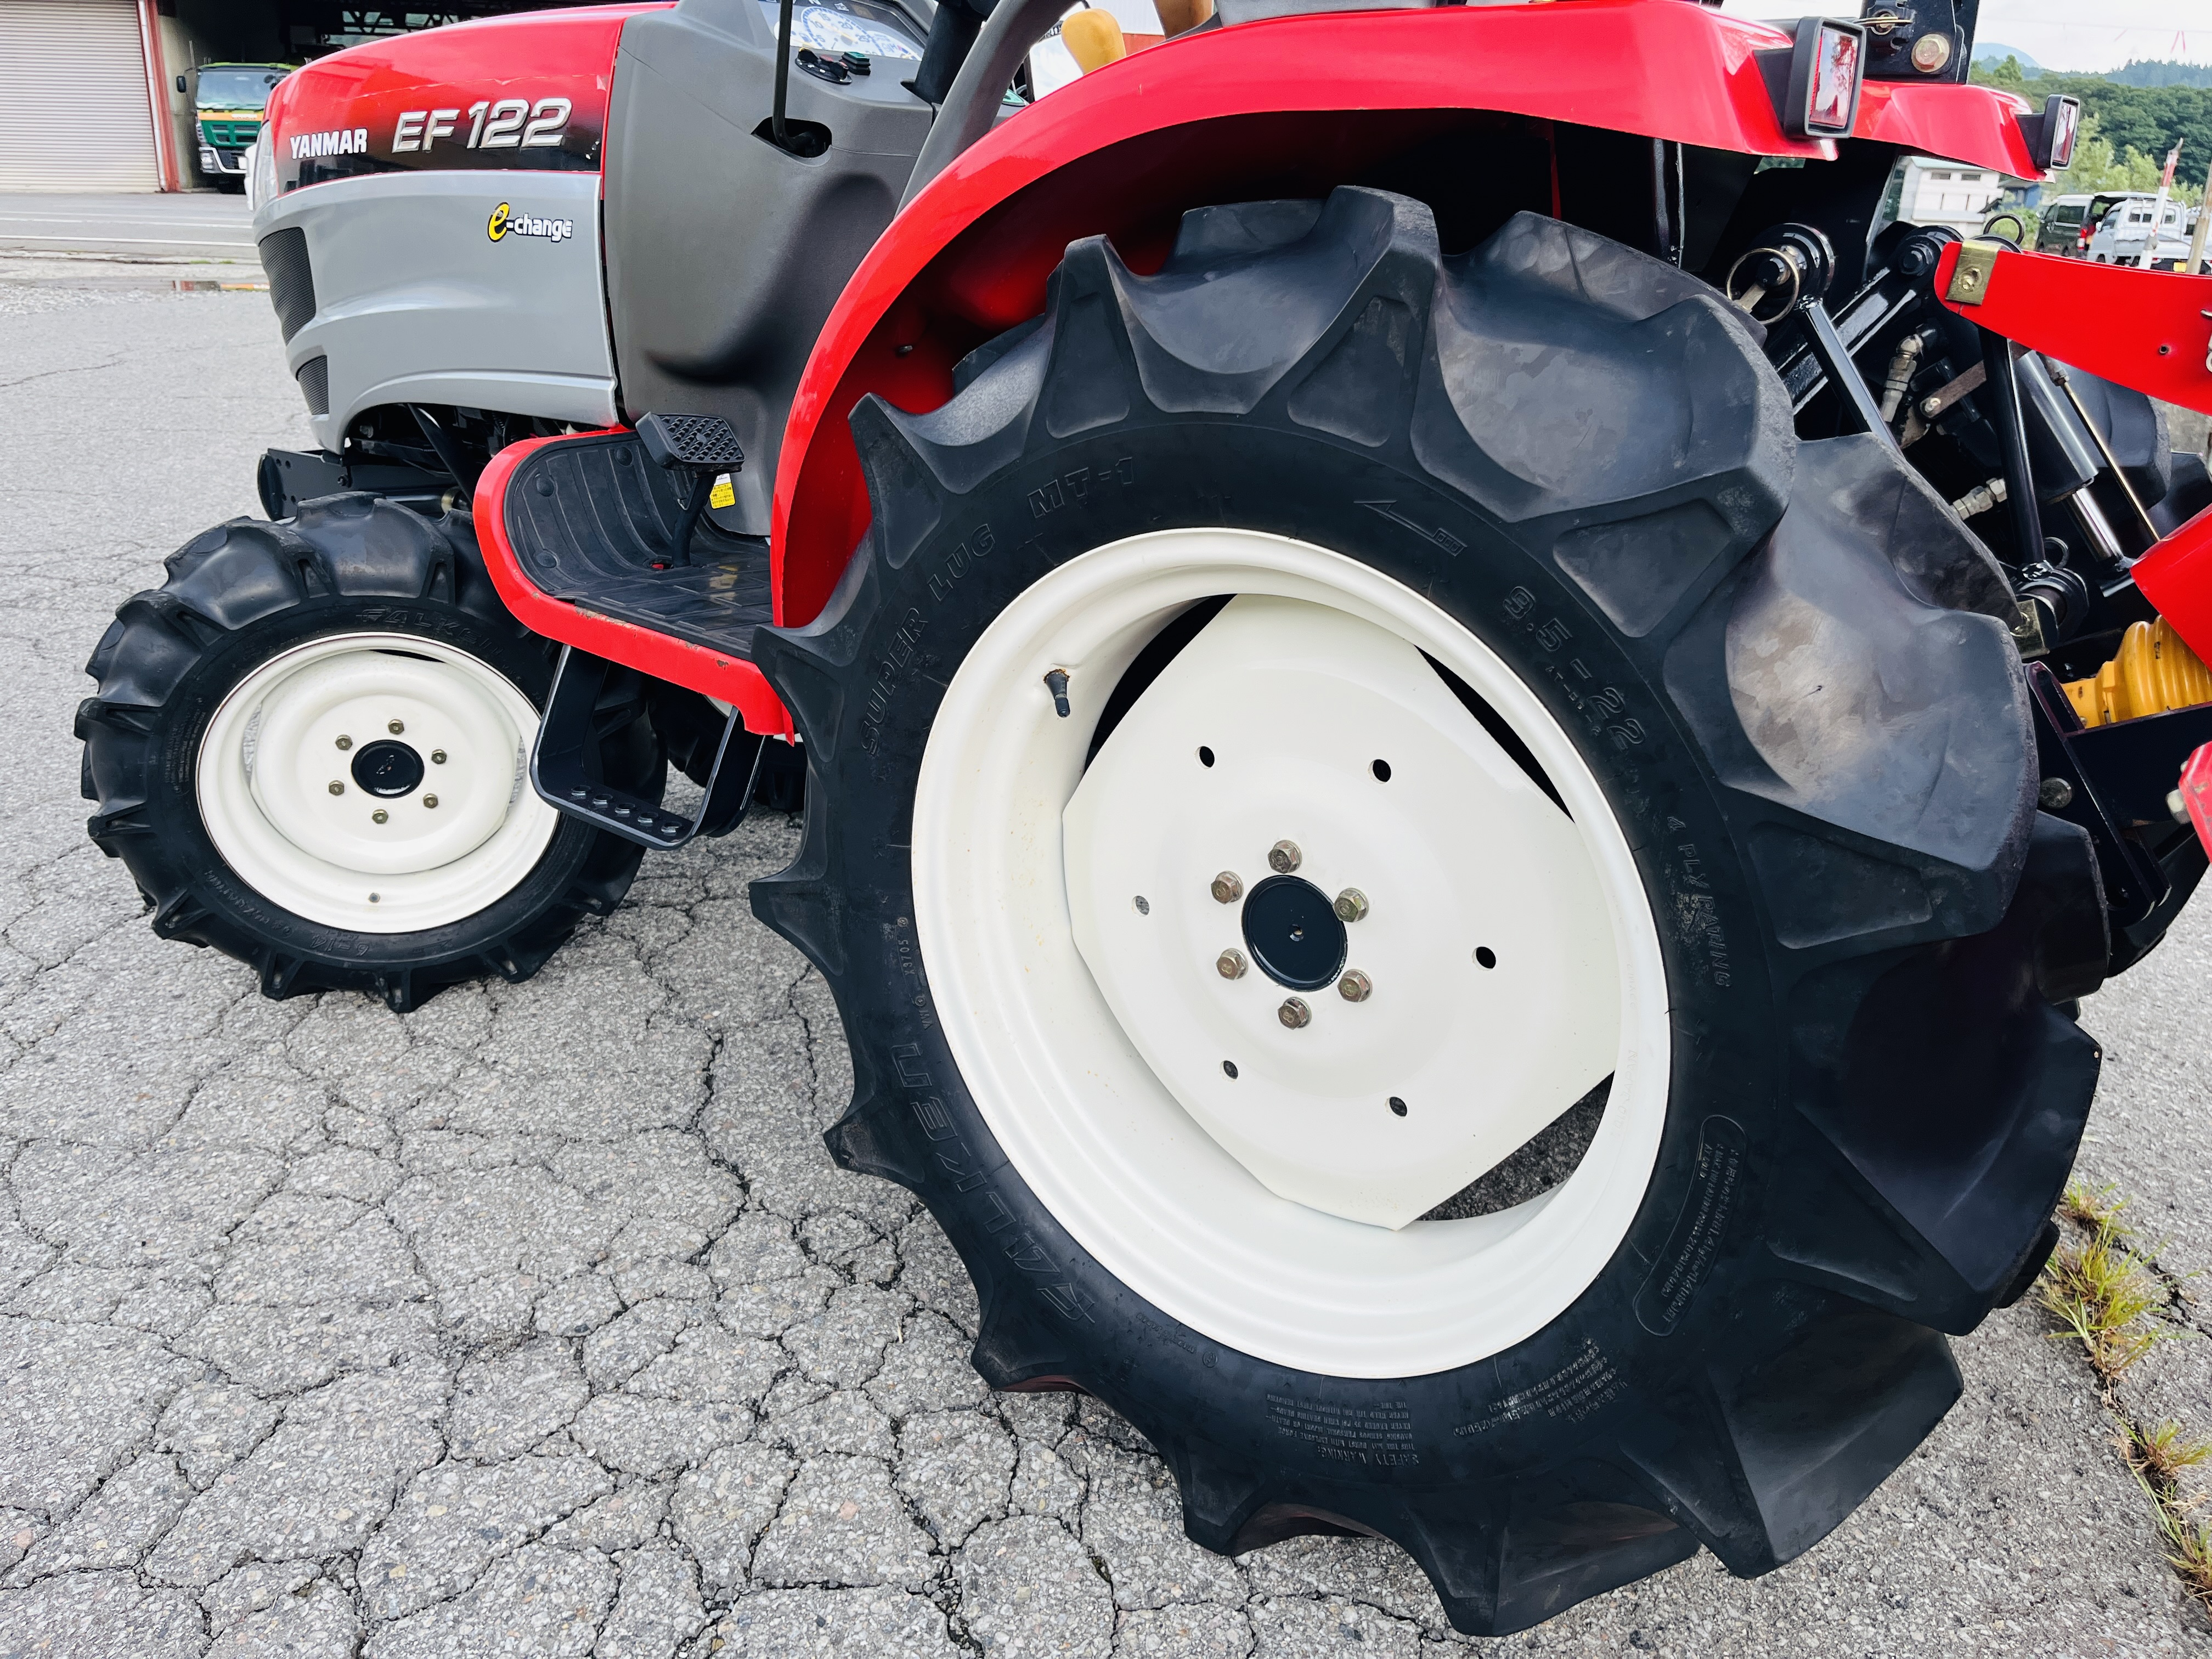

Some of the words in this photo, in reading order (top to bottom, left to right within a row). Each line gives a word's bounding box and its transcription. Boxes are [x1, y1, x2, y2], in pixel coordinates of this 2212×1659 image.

[809, 19, 823, 29] 10
[818, 12, 831, 21] 15
[838, 21, 853, 30] 20
[289, 128, 368, 159] YANMAR
[392, 109, 460, 153] EF
[467, 98, 572, 149] 122
[488, 201, 573, 242] e-change
[858, 607, 928, 758] SUPER
[927, 523, 995, 602] LUG
[1026, 456, 1136, 519] MT-1
[356, 608, 504, 657] FALKEN
[1503, 584, 1647, 751] 9.5-22
[1666, 816, 1687, 833] 4
[1676, 842, 1711, 889] PLY
[1696, 896, 1732, 986] RATING
[890, 1042, 1096, 1325] FALKEN
[1135, 1312, 1162, 1332] JAPAN
[1316, 1445, 1367, 1465] WARNING:
[1374, 1453, 1419, 1466] SAFETY
